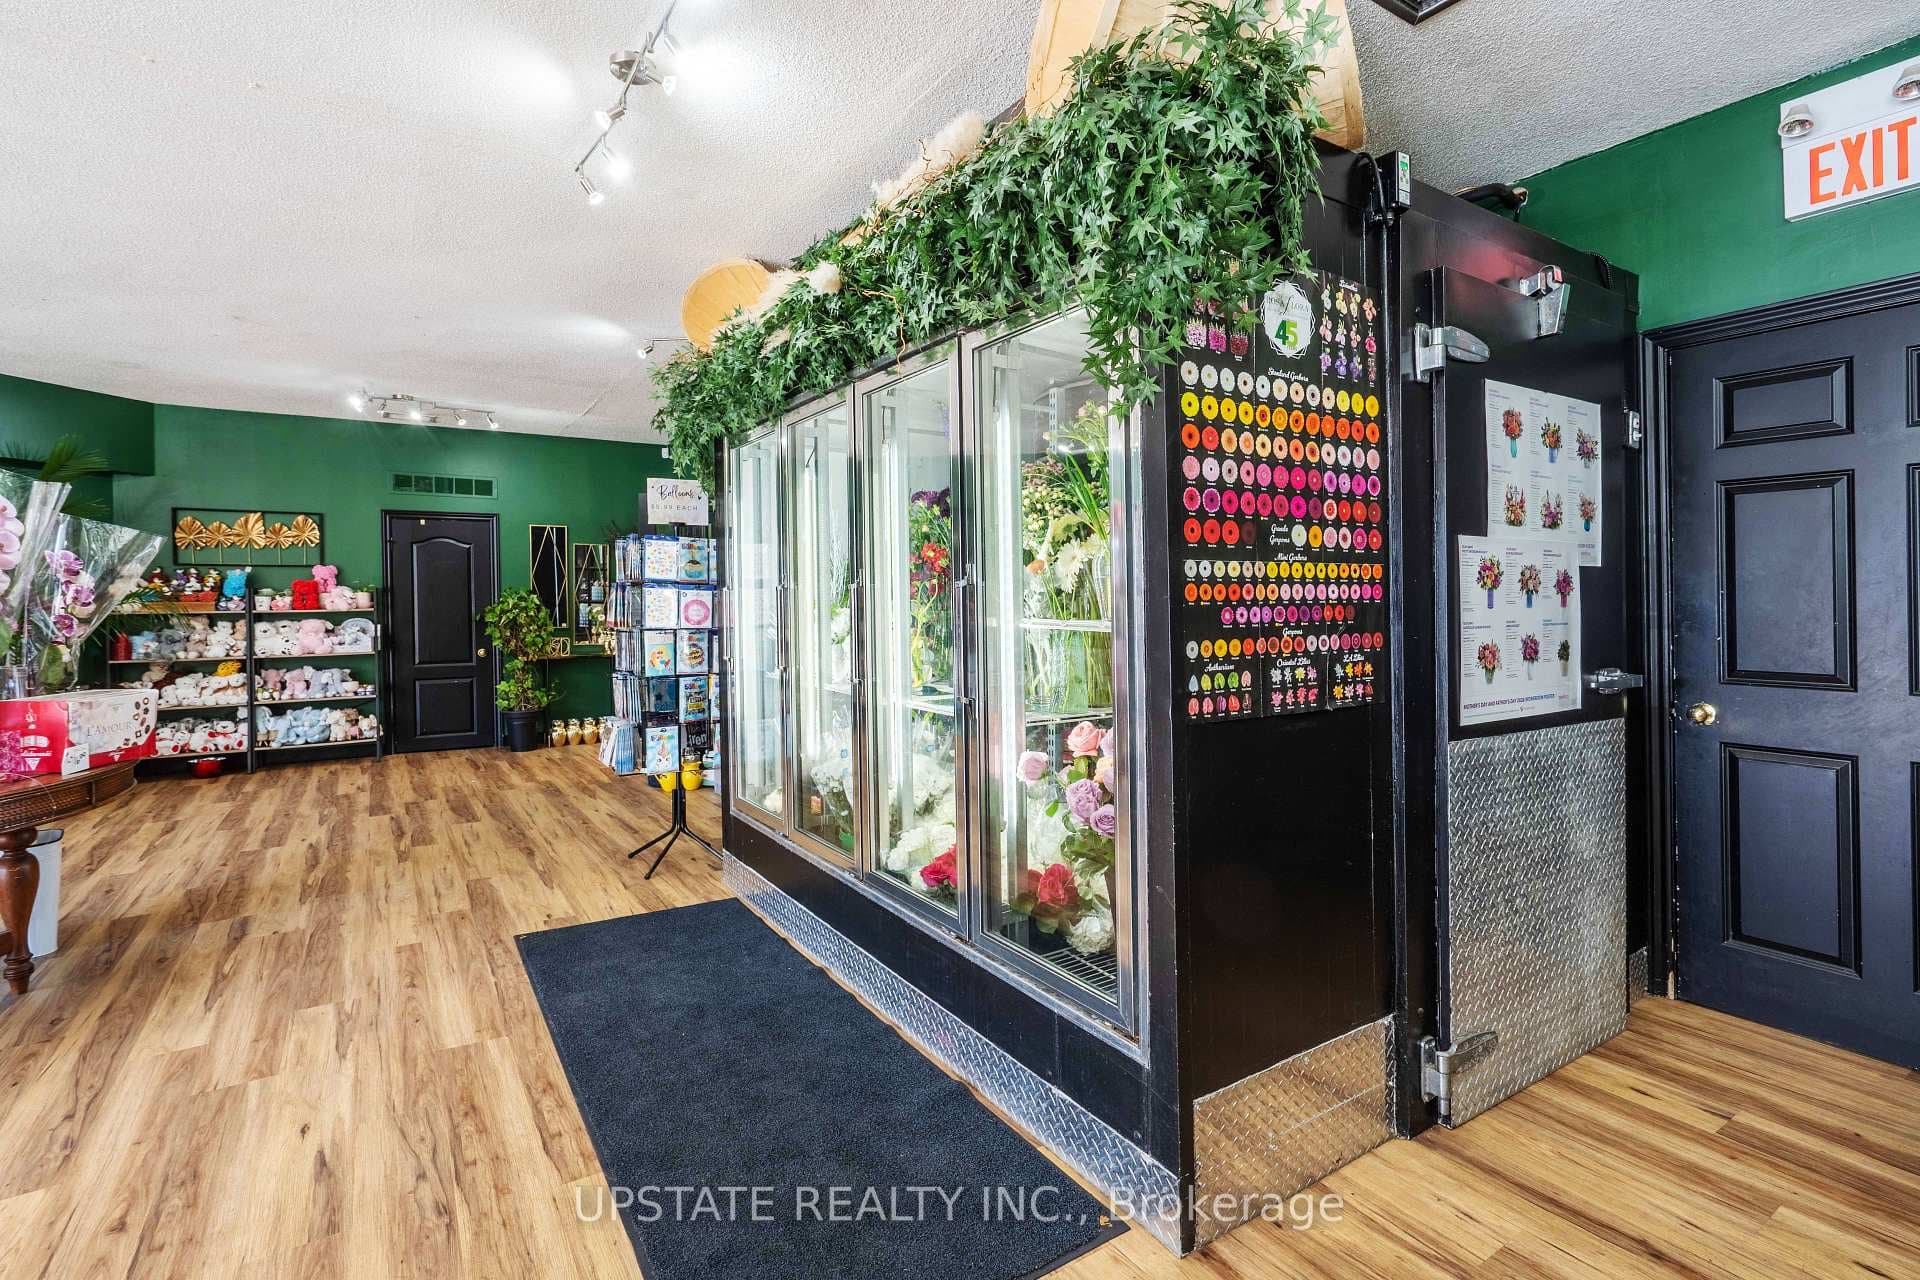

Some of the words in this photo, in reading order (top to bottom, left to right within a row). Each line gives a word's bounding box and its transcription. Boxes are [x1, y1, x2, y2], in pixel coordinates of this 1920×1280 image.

[1809, 115, 1917, 206] EXIT
[1274, 319, 1298, 348] 45
[657, 484, 696, 501] Balloons
